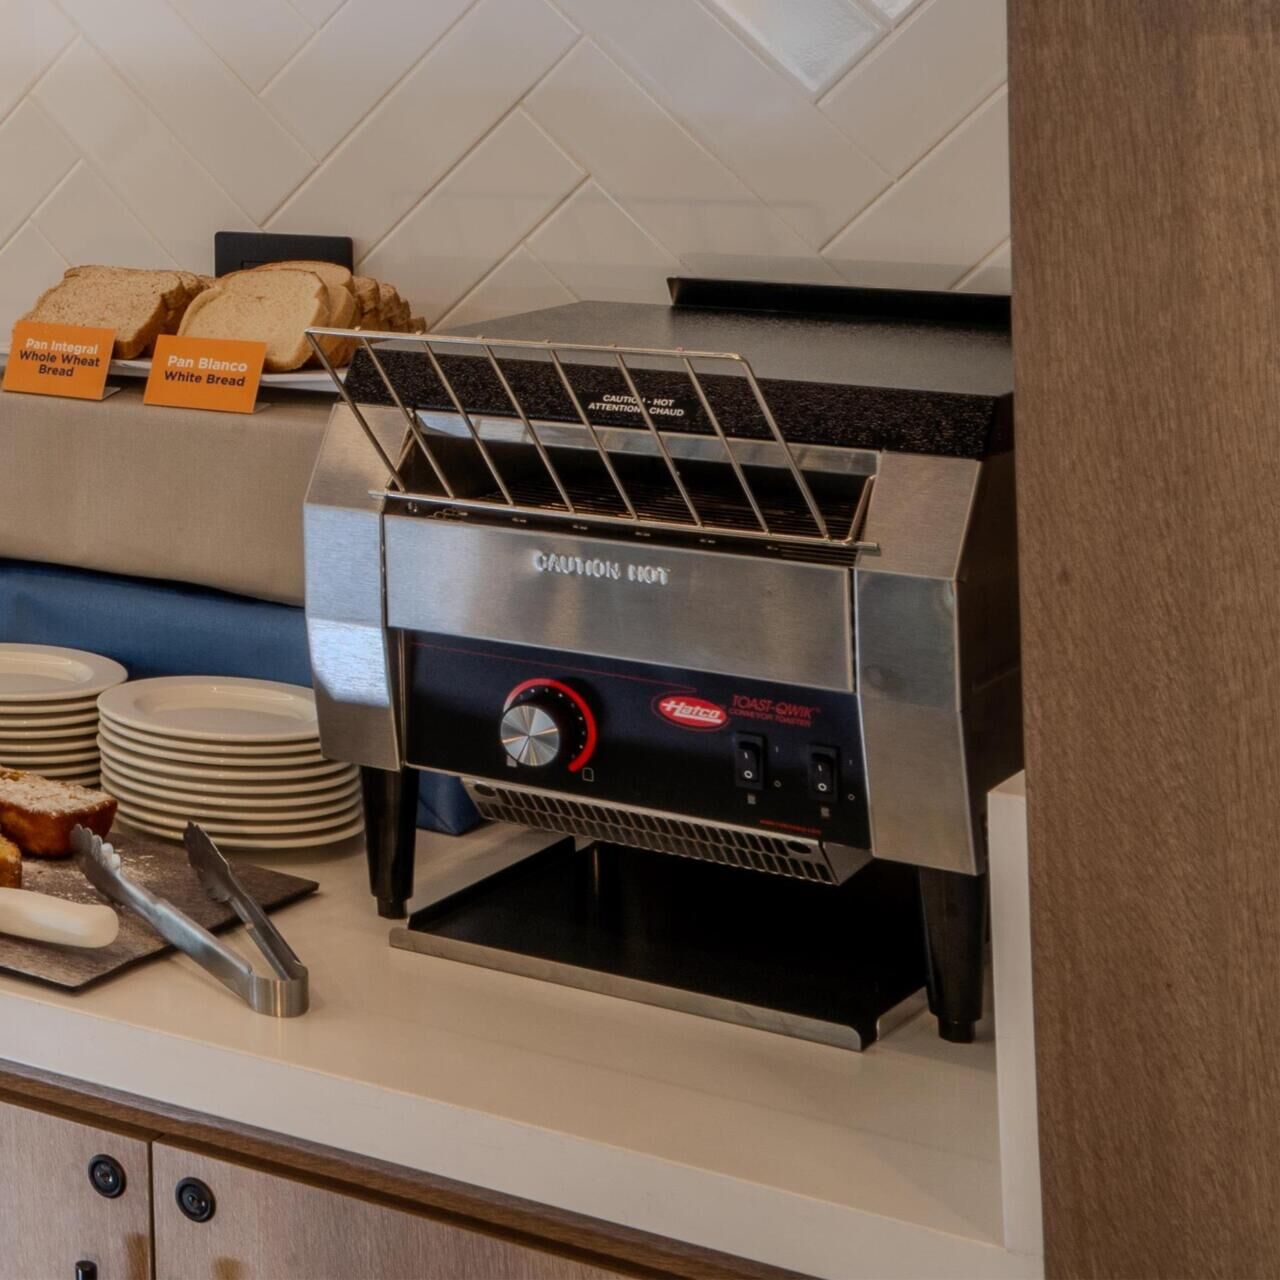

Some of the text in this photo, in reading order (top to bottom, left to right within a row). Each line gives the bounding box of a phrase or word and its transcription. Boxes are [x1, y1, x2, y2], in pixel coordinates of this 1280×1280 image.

[26, 338, 98, 355] Pan Integral
[20, 350, 100, 367] Whole Wheat
[168, 355, 248, 372] Pan Blanco
[38, 365, 74, 378] Bread
[164, 371, 246, 387] White Bread
[588, 402, 685, 416] ATTENTION CHAUD
[653, 398, 675, 406] HOT
[532, 549, 671, 586] CAUTION HOT
[662, 700, 722, 723] Hatco
